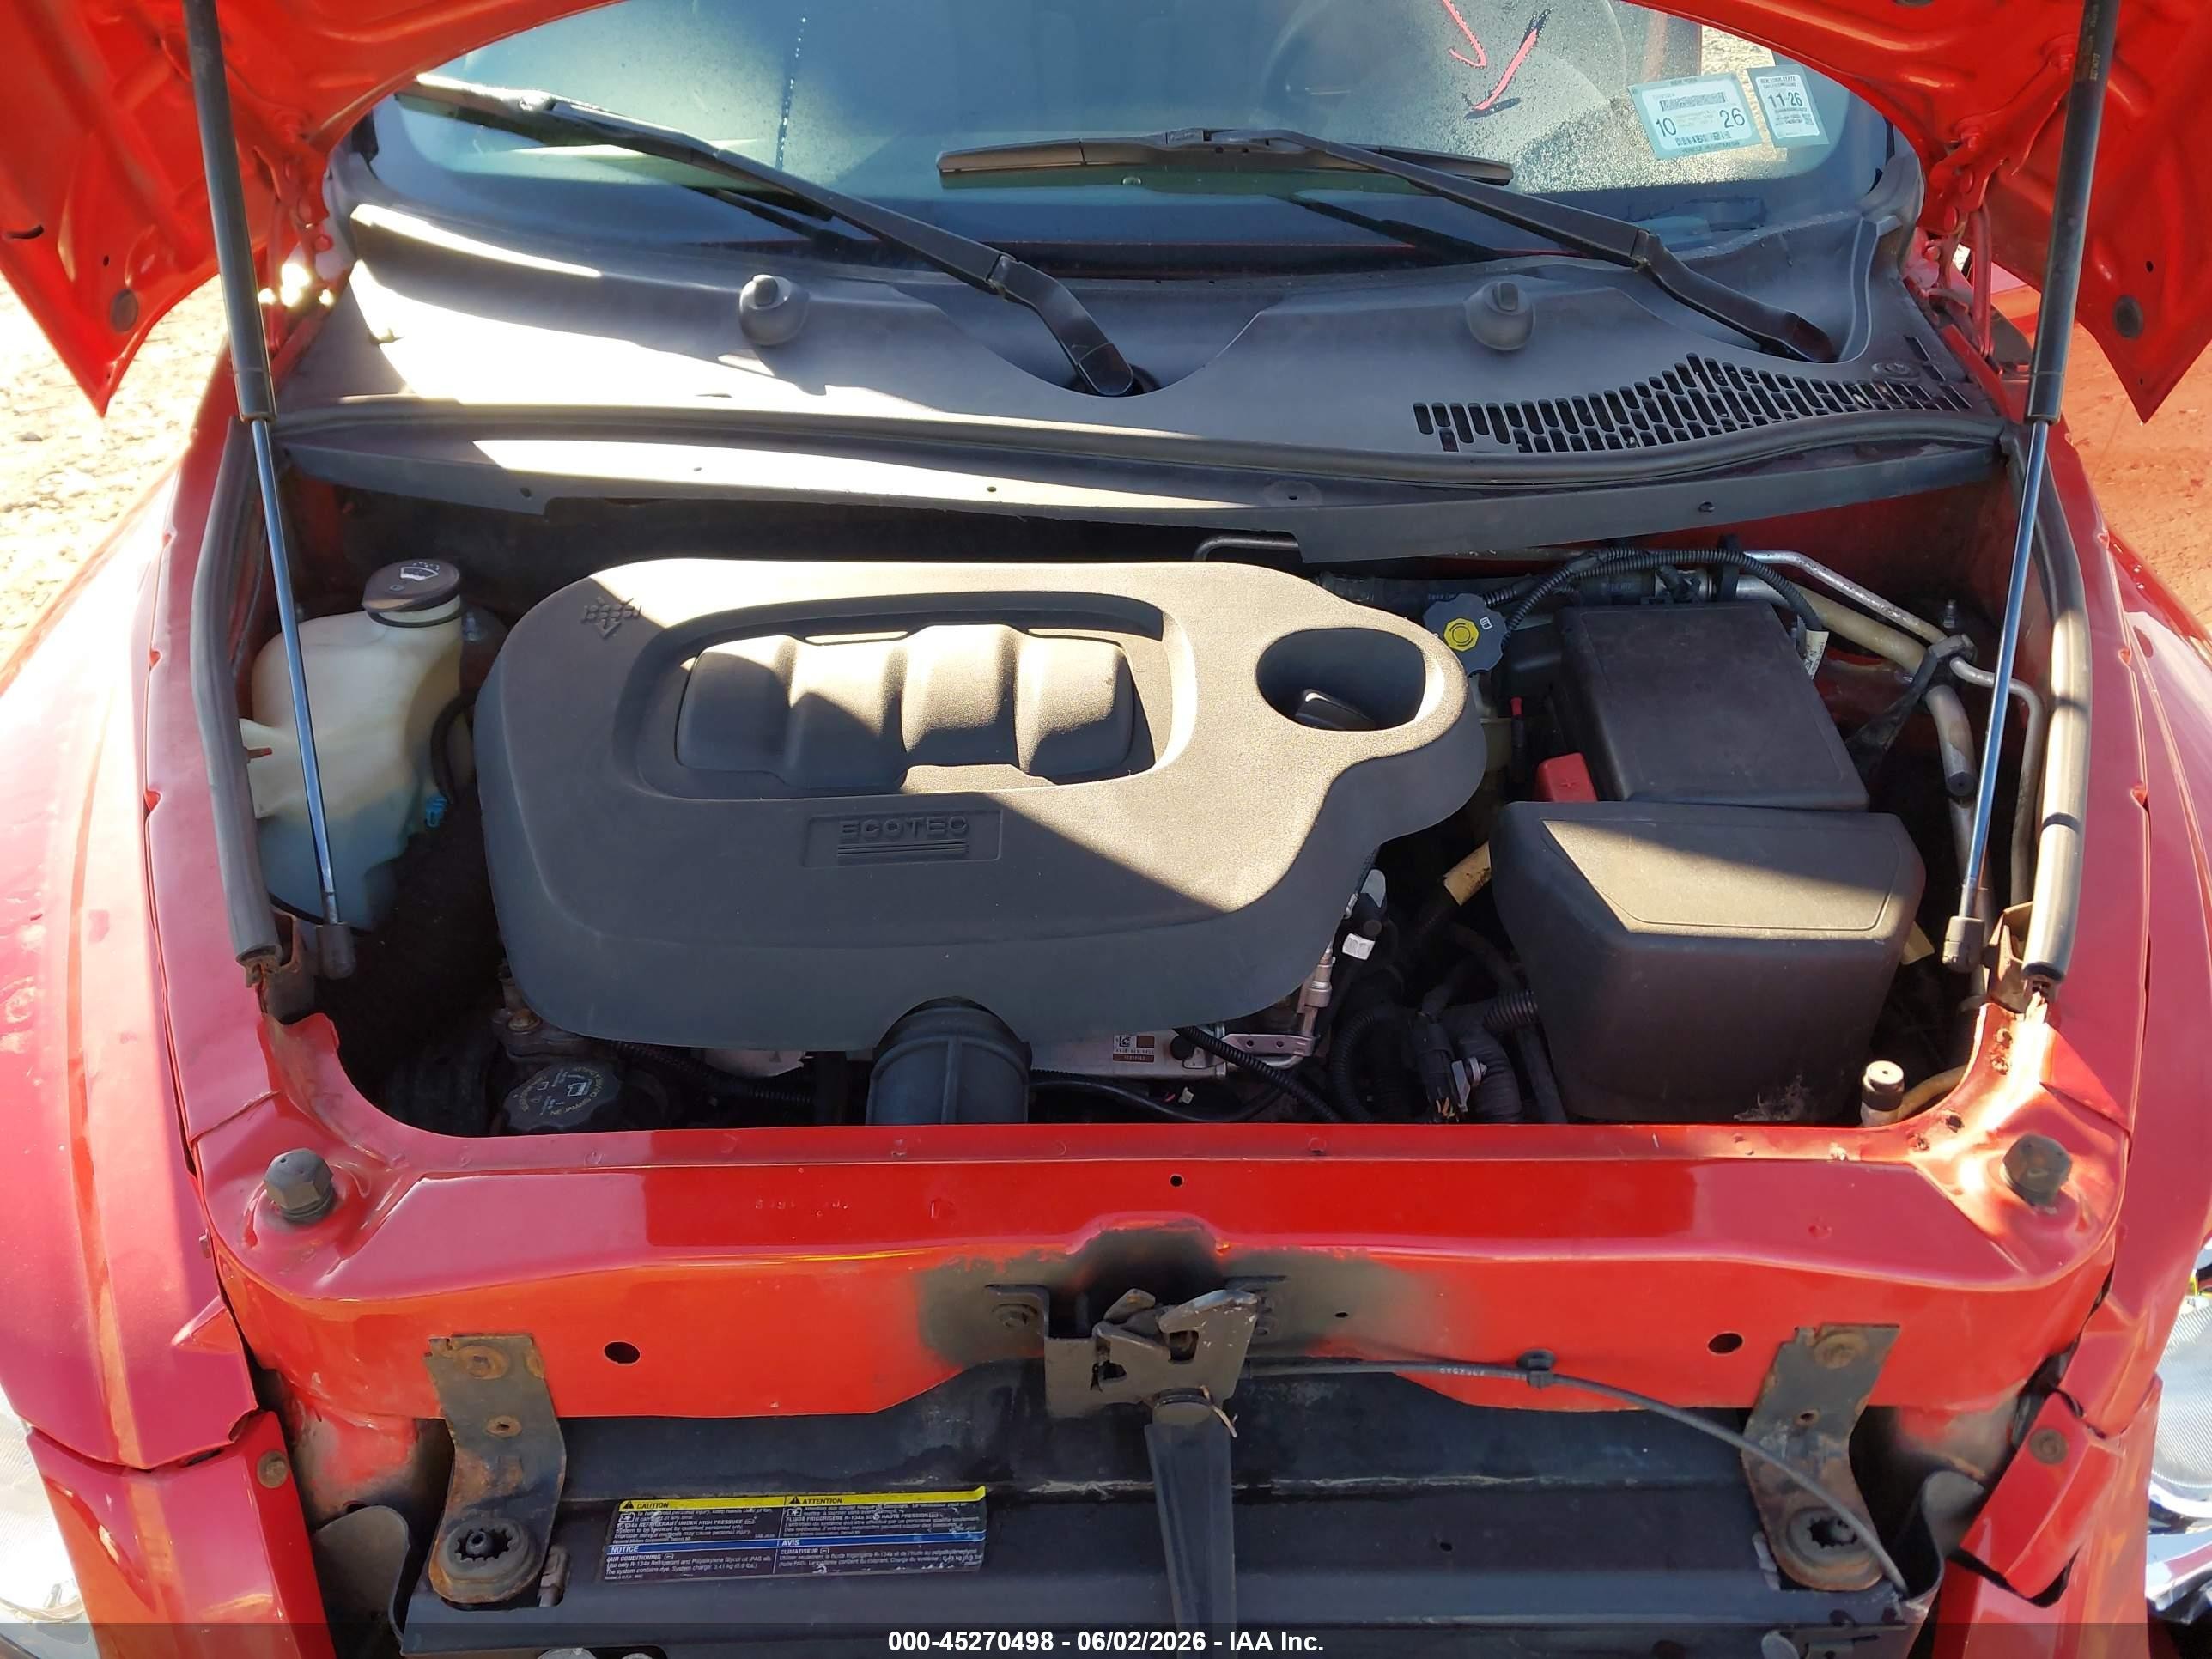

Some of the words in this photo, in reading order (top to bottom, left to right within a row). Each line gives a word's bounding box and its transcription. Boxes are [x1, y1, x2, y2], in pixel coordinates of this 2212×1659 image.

[1768, 92, 1786, 108] 11
[1788, 92, 1802, 106] 26
[1655, 117, 1677, 137] 10
[1719, 107, 1746, 128] 26
[839, 815, 969, 838] ECOTEC
[611, 1545, 639, 1553] NOTICE
